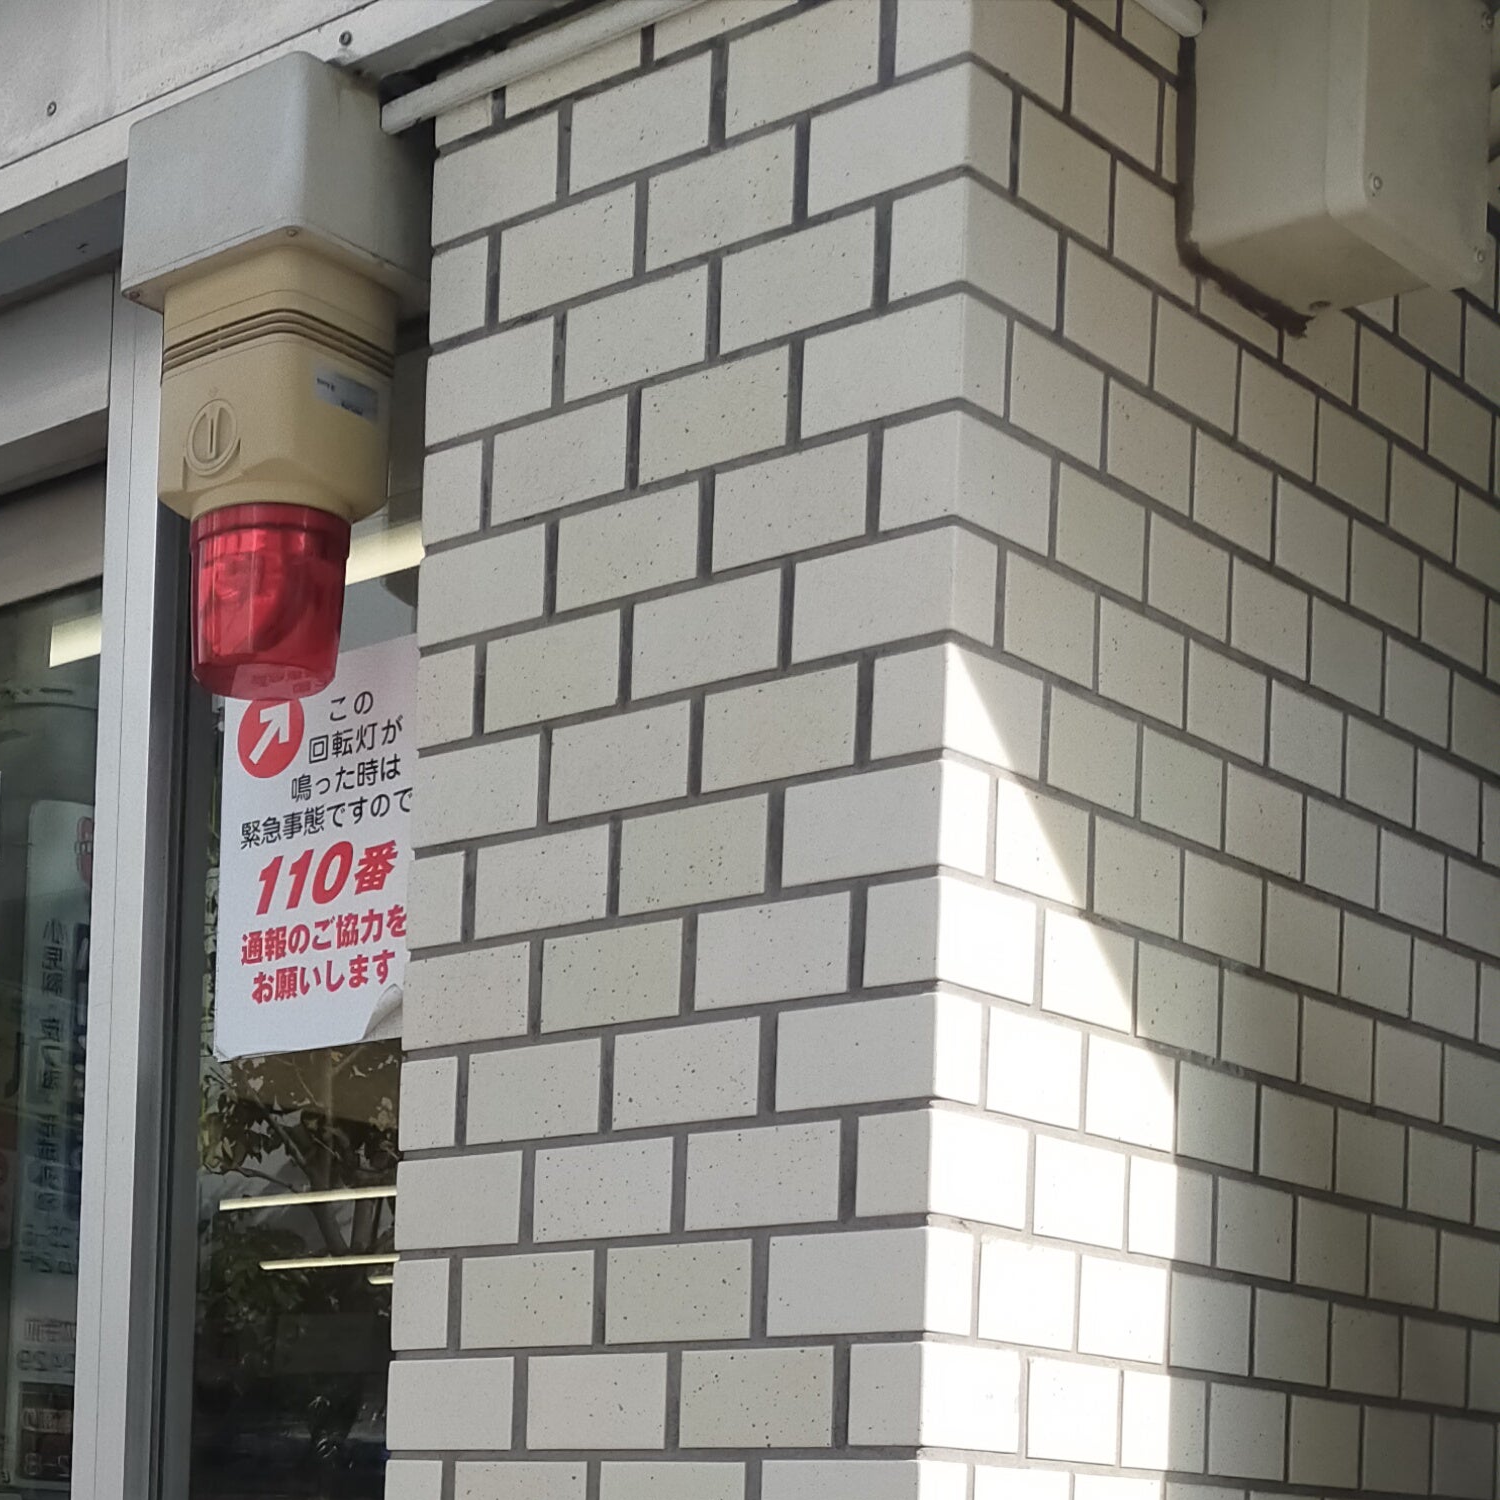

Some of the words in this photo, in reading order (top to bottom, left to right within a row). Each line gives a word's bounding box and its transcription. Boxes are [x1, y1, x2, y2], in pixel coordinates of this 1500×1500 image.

[330, 690, 374, 722] この
[308, 715, 404, 765] 回転灯が
[291, 753, 402, 803] 鳴った時は
[240, 787, 413, 850] 緊急事態ですので
[256, 840, 399, 916] 110番
[241, 904, 408, 966] 通報のご協力を
[252, 949, 396, 1005] お願いします
